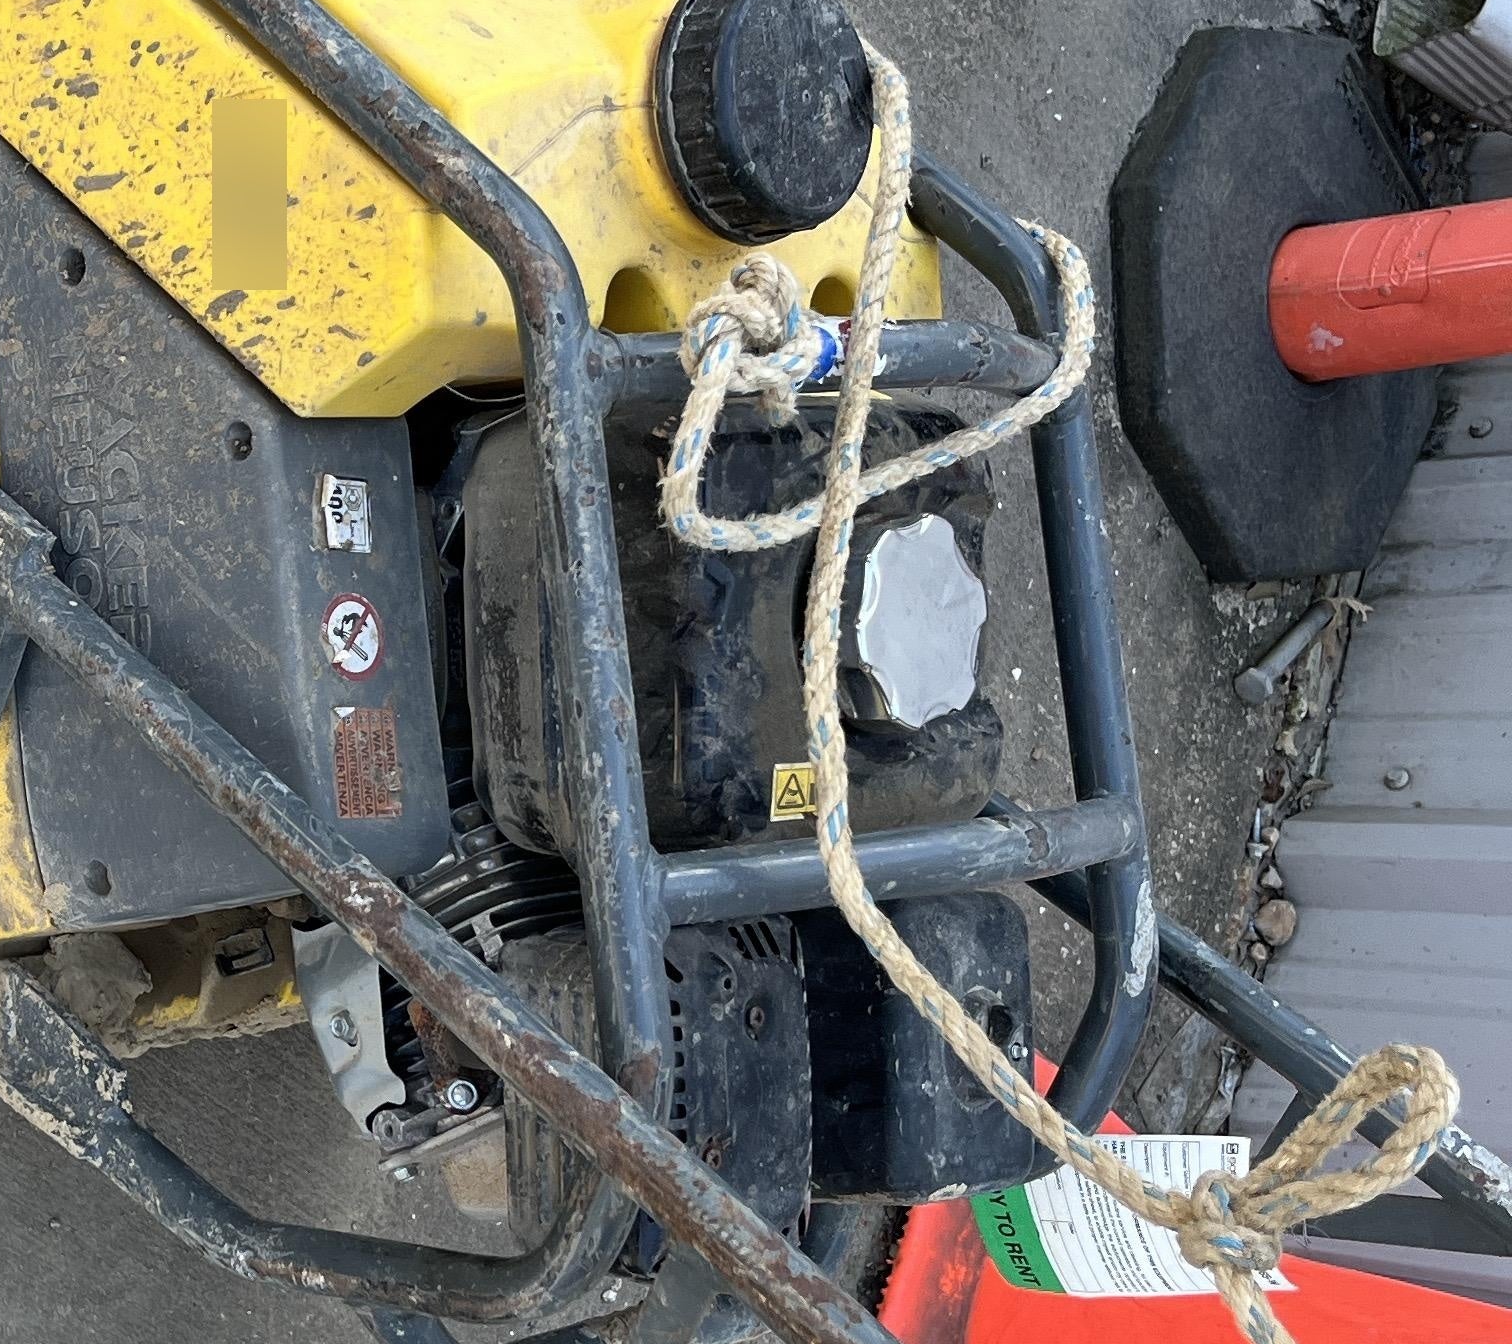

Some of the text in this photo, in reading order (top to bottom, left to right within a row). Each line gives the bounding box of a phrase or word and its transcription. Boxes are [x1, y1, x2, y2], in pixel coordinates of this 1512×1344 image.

[49, 333, 104, 611] NEUSO
[372, 730, 386, 804] WARNNG
[994, 1212, 1016, 1237] TO
[1003, 1242, 1042, 1287] RENT
